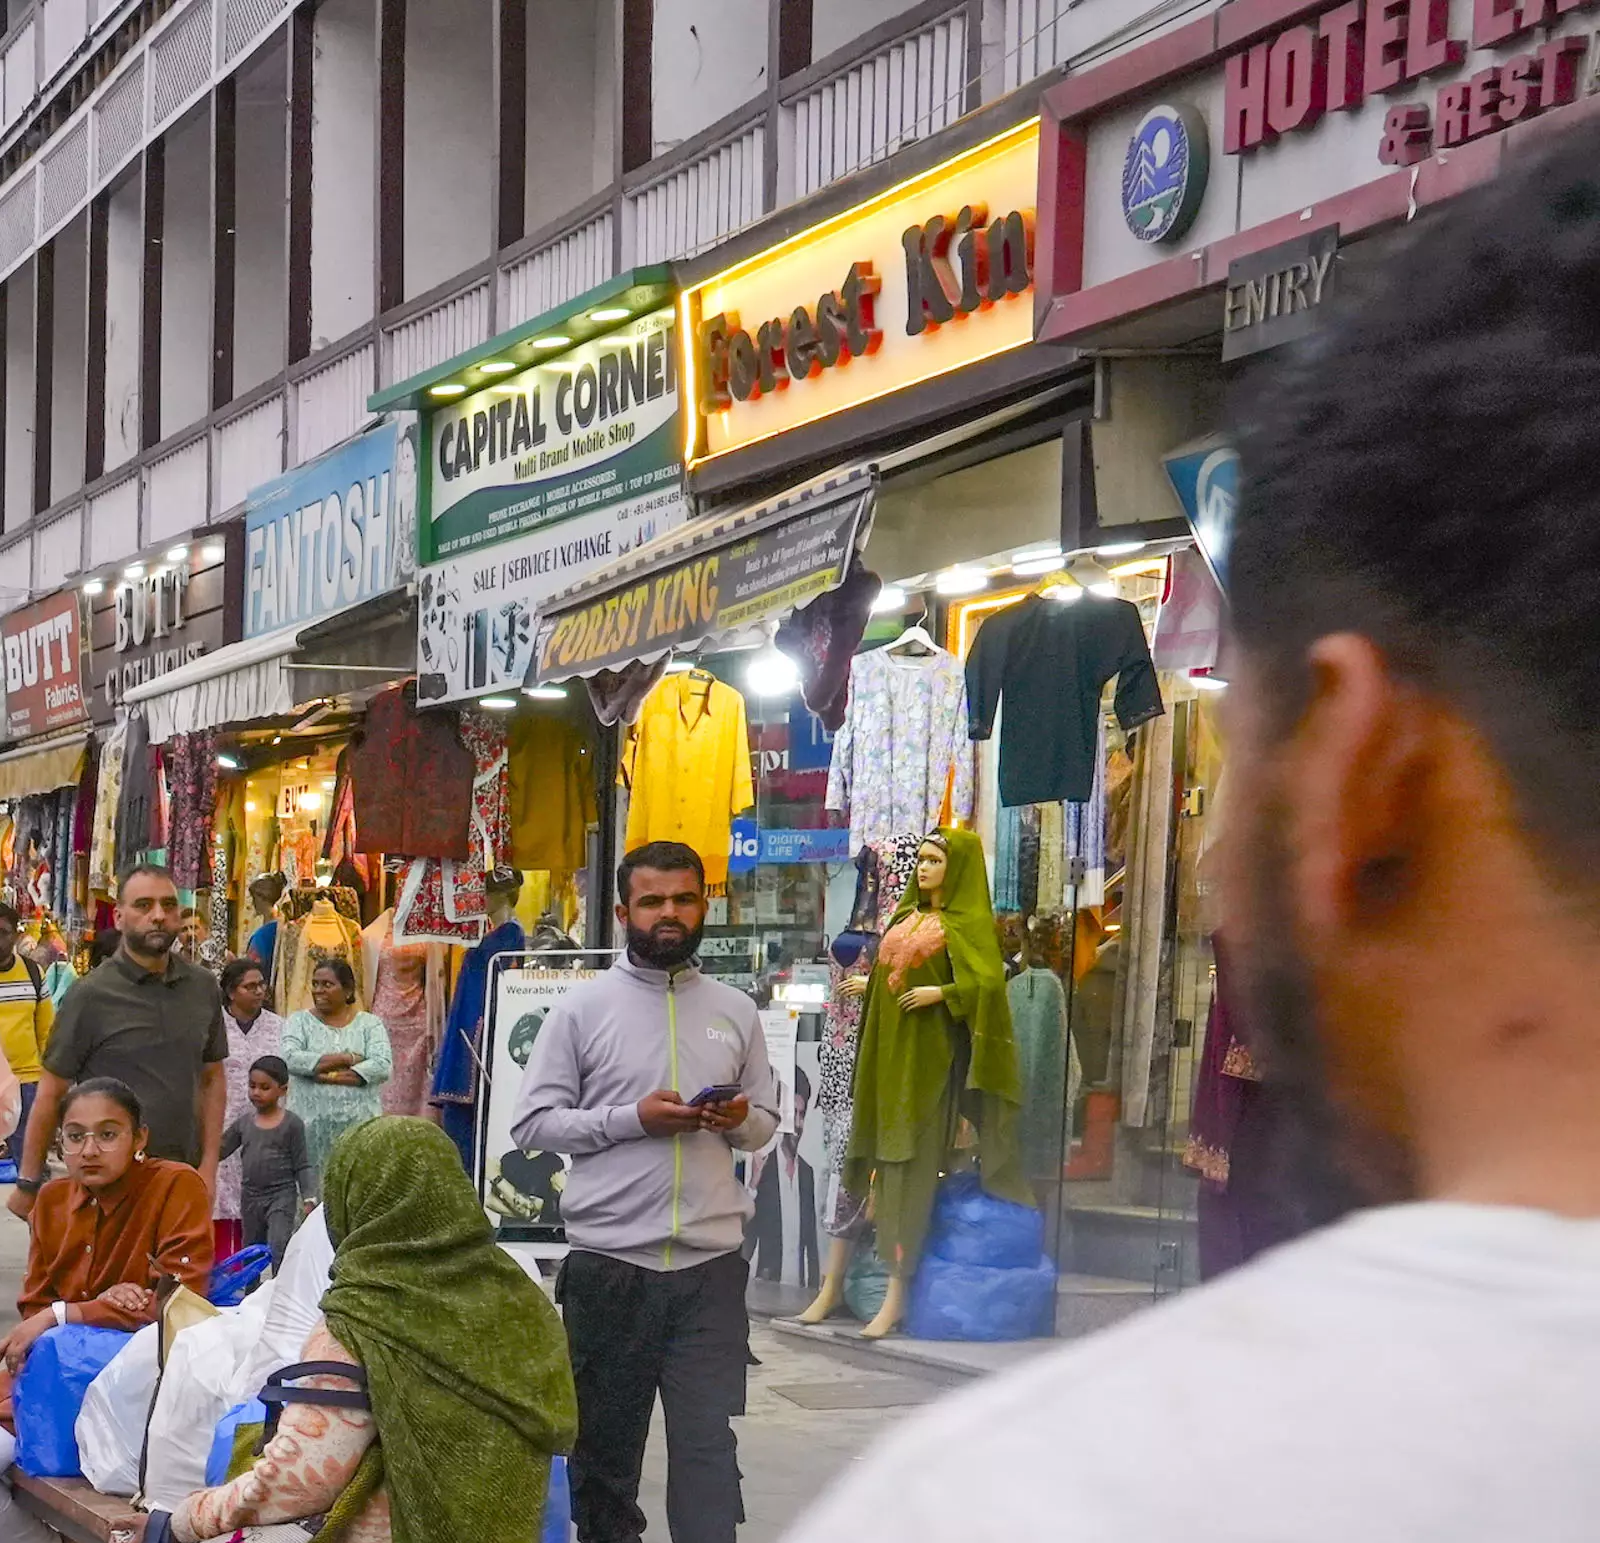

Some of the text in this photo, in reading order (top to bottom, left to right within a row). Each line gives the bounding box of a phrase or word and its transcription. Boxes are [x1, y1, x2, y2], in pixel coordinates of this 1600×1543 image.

[1224, 0, 1464, 155] HOTEL
[1377, 103, 1434, 166] &
[1224, 250, 1332, 333] ENTRY
[700, 262, 880, 415] Forest
[439, 384, 548, 482] CAPITAL
[514, 421, 636, 480] Multi Brand Mobile Shop
[508, 495, 541, 517] EXCHANGE
[571, 469, 617, 494] ACCESSORIES
[473, 566, 497, 594] SALE
[508, 549, 551, 583] SERVICE
[114, 564, 190, 653] BUTT
[542, 583, 649, 670] FOREST
[646, 556, 720, 640] KING
[5, 610, 73, 694] BUTT
[44, 681, 80, 711] Fabrics
[768, 834, 814, 845] DIGITAL
[768, 846, 793, 856] LIFE
[506, 985, 555, 995] Wearable
[521, 967, 570, 980] India's
[706, 1027, 726, 1042] Dry
